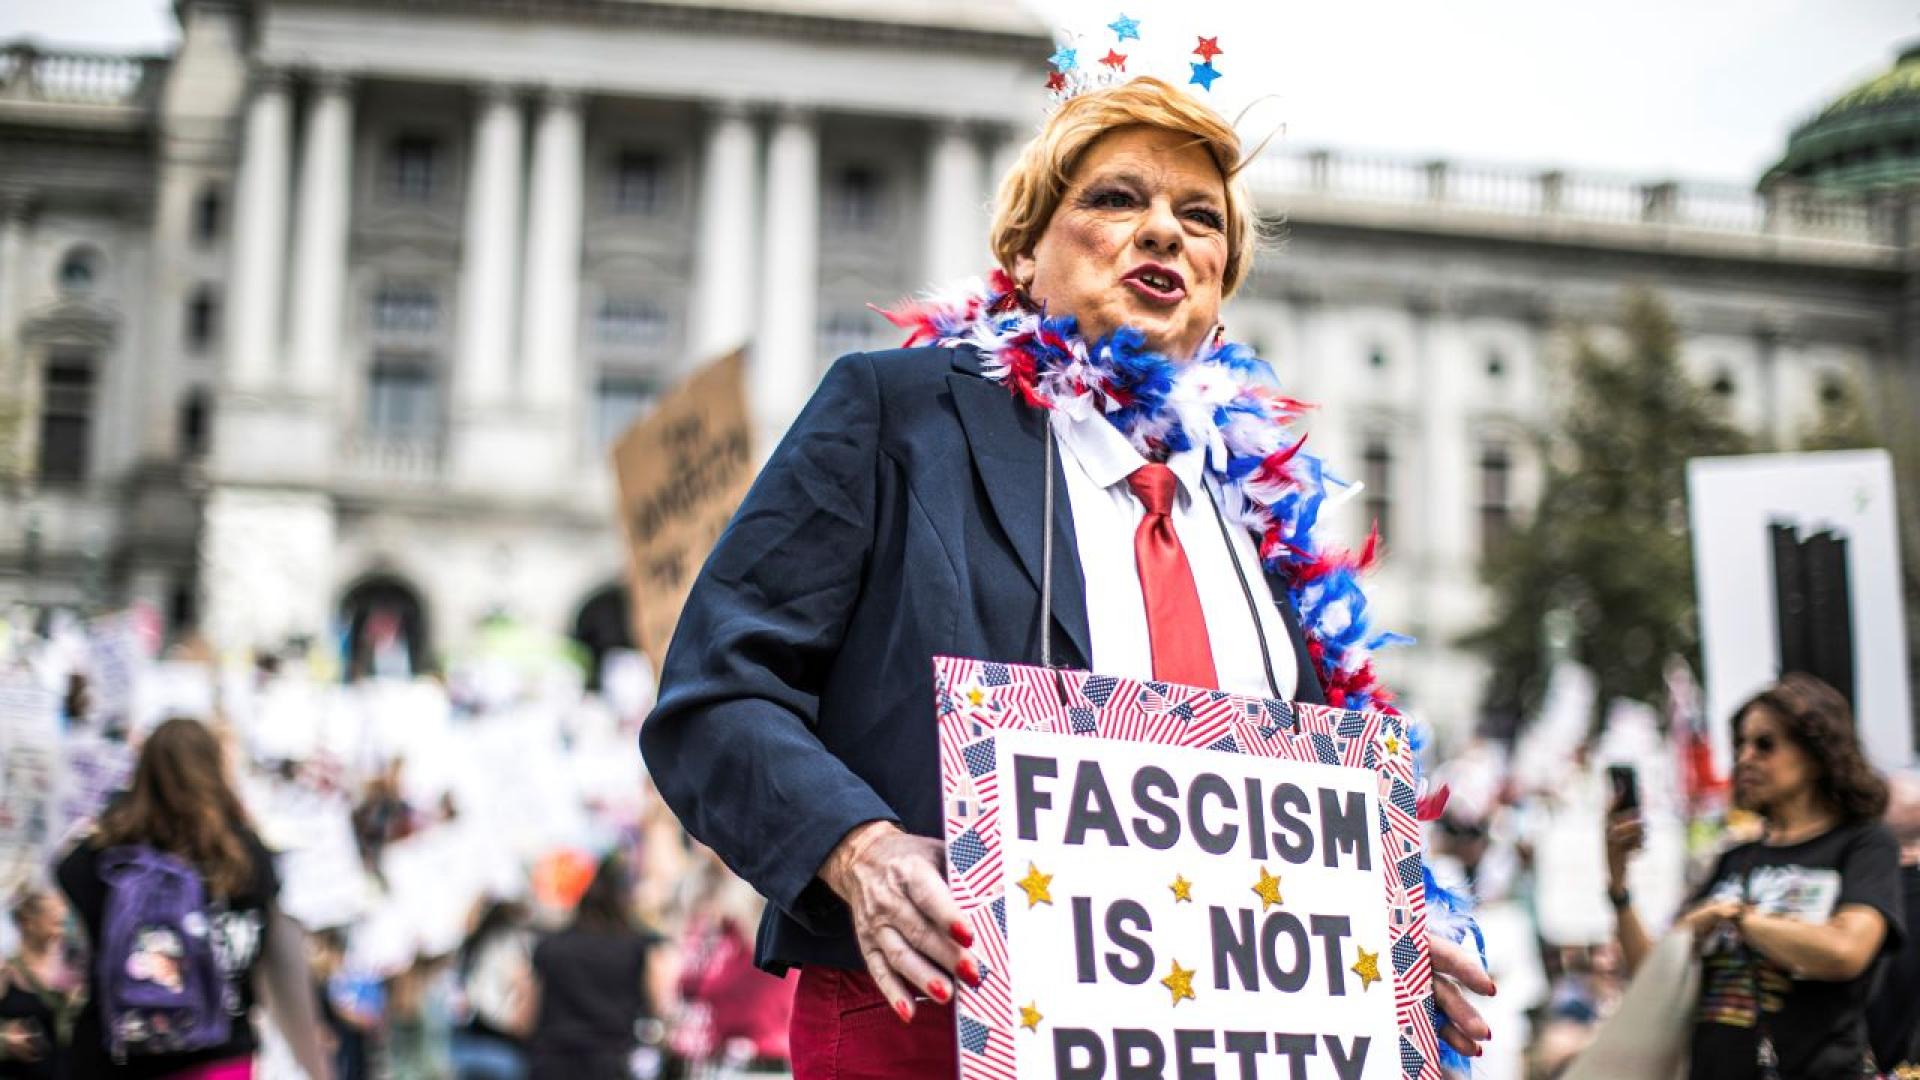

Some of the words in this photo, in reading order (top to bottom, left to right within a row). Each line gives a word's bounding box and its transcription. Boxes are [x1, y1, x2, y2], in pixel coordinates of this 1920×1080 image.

[1013, 753, 1372, 872] FASCISM
[1071, 896, 1156, 985] IS
[1209, 905, 1352, 997] NOT
